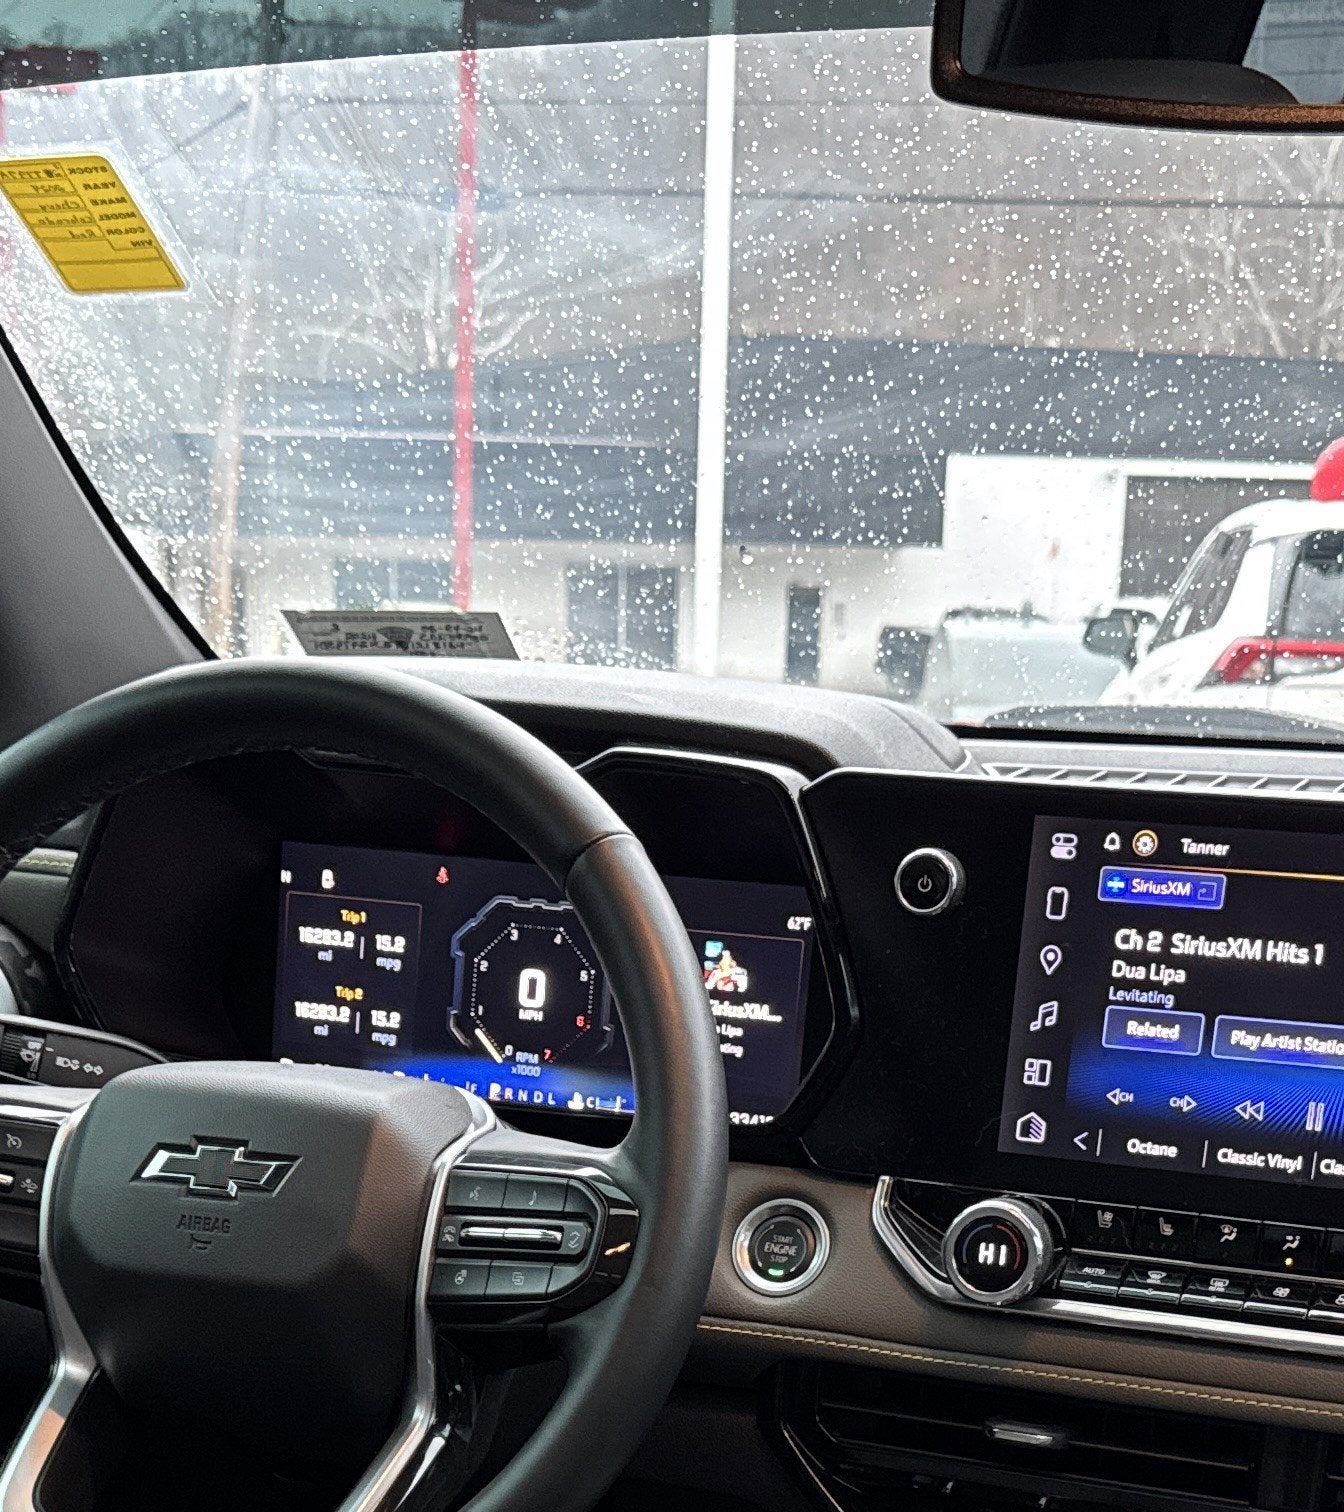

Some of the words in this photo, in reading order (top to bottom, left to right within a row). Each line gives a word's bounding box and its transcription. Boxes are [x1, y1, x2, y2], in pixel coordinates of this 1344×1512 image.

[1181, 838, 1230, 856] Tanner
[1131, 878, 1192, 897] SiriusXM
[509, 928, 519, 941] 3
[375, 934, 406, 953] 15.2
[1114, 928, 1143, 951] Ch
[1146, 931, 1164, 952] 2
[1170, 932, 1263, 962] SiriusXM
[1266, 940, 1310, 964] Hits
[1314, 943, 1325, 966] 1
[376, 957, 402, 972] mpg
[479, 960, 489, 972] 2
[579, 970, 589, 982] 5
[1111, 960, 1146, 980] Dua
[1150, 963, 1186, 985] Lipa
[518, 968, 546, 1008] 0
[1108, 985, 1175, 1009] Levitating
[371, 1009, 401, 1029] 15.2
[518, 1008, 544, 1021] MPH
[575, 1015, 585, 1027] 6
[1126, 1020, 1181, 1041] Related
[371, 1032, 397, 1047] mpg
[1230, 1029, 1260, 1051] Play
[1260, 1033, 1303, 1052] Artist
[504, 1044, 514, 1056] 0
[543, 1048, 553, 1061] 7
[515, 1051, 539, 1065] RPM
[488, 1082, 502, 1101] P
[518, 1089, 529, 1102] N
[533, 1090, 544, 1103] D
[1119, 1091, 1134, 1103] CH
[1169, 1096, 1185, 1108] CH
[1127, 1138, 1178, 1158] Octane
[1217, 1148, 1265, 1168] Classic
[1267, 1153, 1303, 1173] Vinyl
[177, 1214, 231, 1233] AIRBAG
[773, 1234, 794, 1244] START
[764, 1241, 798, 1256] ENGINE
[978, 1242, 1007, 1266] HI
[770, 1254, 789, 1263] STOP
[1081, 1266, 1106, 1275] AUTO
